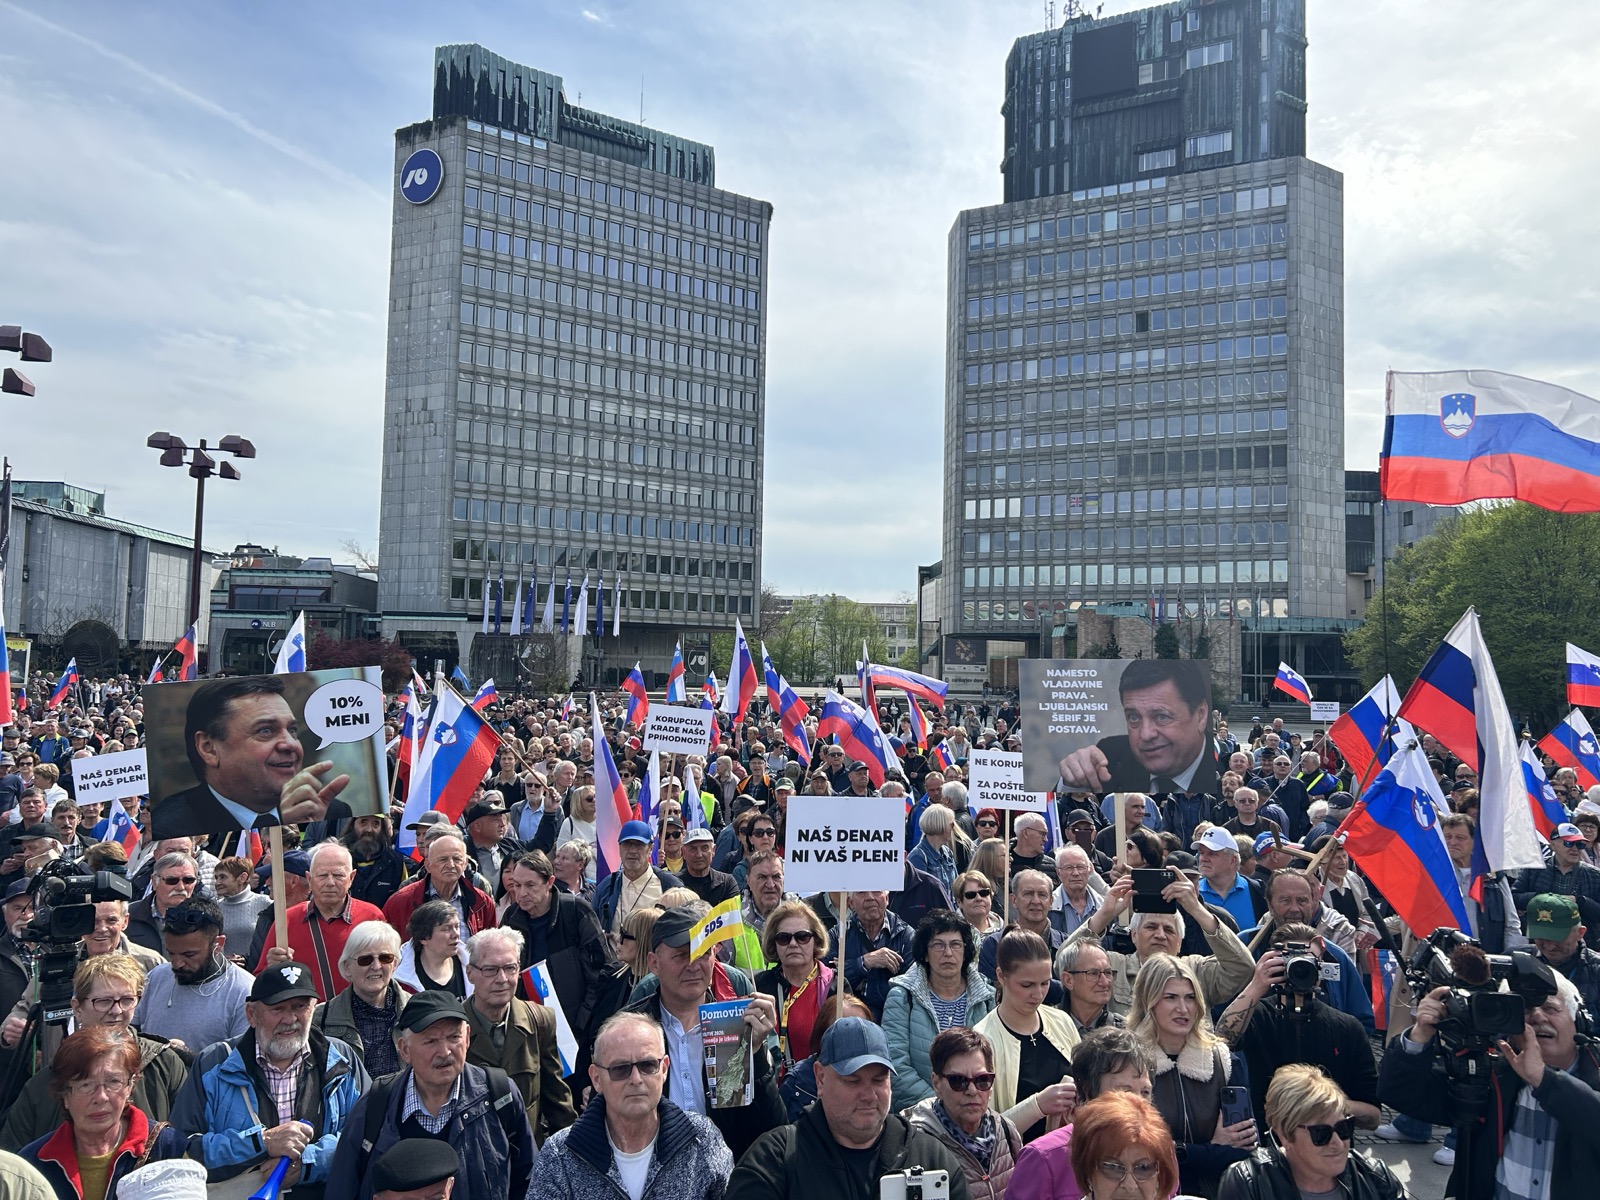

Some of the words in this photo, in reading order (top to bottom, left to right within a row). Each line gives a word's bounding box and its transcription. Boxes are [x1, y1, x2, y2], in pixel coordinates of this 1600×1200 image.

[1046, 669, 1098, 677] NAMESTO
[1042, 680, 1103, 688] VLADAVINE
[1051, 691, 1088, 700] PRAVA
[330, 696, 363, 709] 10%
[1038, 702, 1108, 711] LJUBLJANSKI
[326, 712, 370, 728] MENI
[655, 715, 703, 726] KORUPCIJA
[1051, 712, 1081, 722] ŠERIF
[1083, 714, 1096, 722] JE
[650, 724, 680, 734] KRADE
[682, 727, 706, 736] NAŠO
[1048, 725, 1101, 734] POSTAVA.
[80, 769, 102, 780] NAŠ
[105, 764, 142, 776] DENAR
[92, 778, 114, 788] VAŠ
[116, 774, 146, 784] PLEN!
[978, 780, 990, 788] ZA
[980, 792, 1036, 802] SLOVENIJO!
[798, 826, 832, 842] NAŠ
[836, 830, 894, 842] DENAR
[792, 850, 809, 862] NI
[814, 846, 848, 862] VAŠ
[852, 850, 898, 862] PLEN!
[704, 916, 723, 938] SDS
